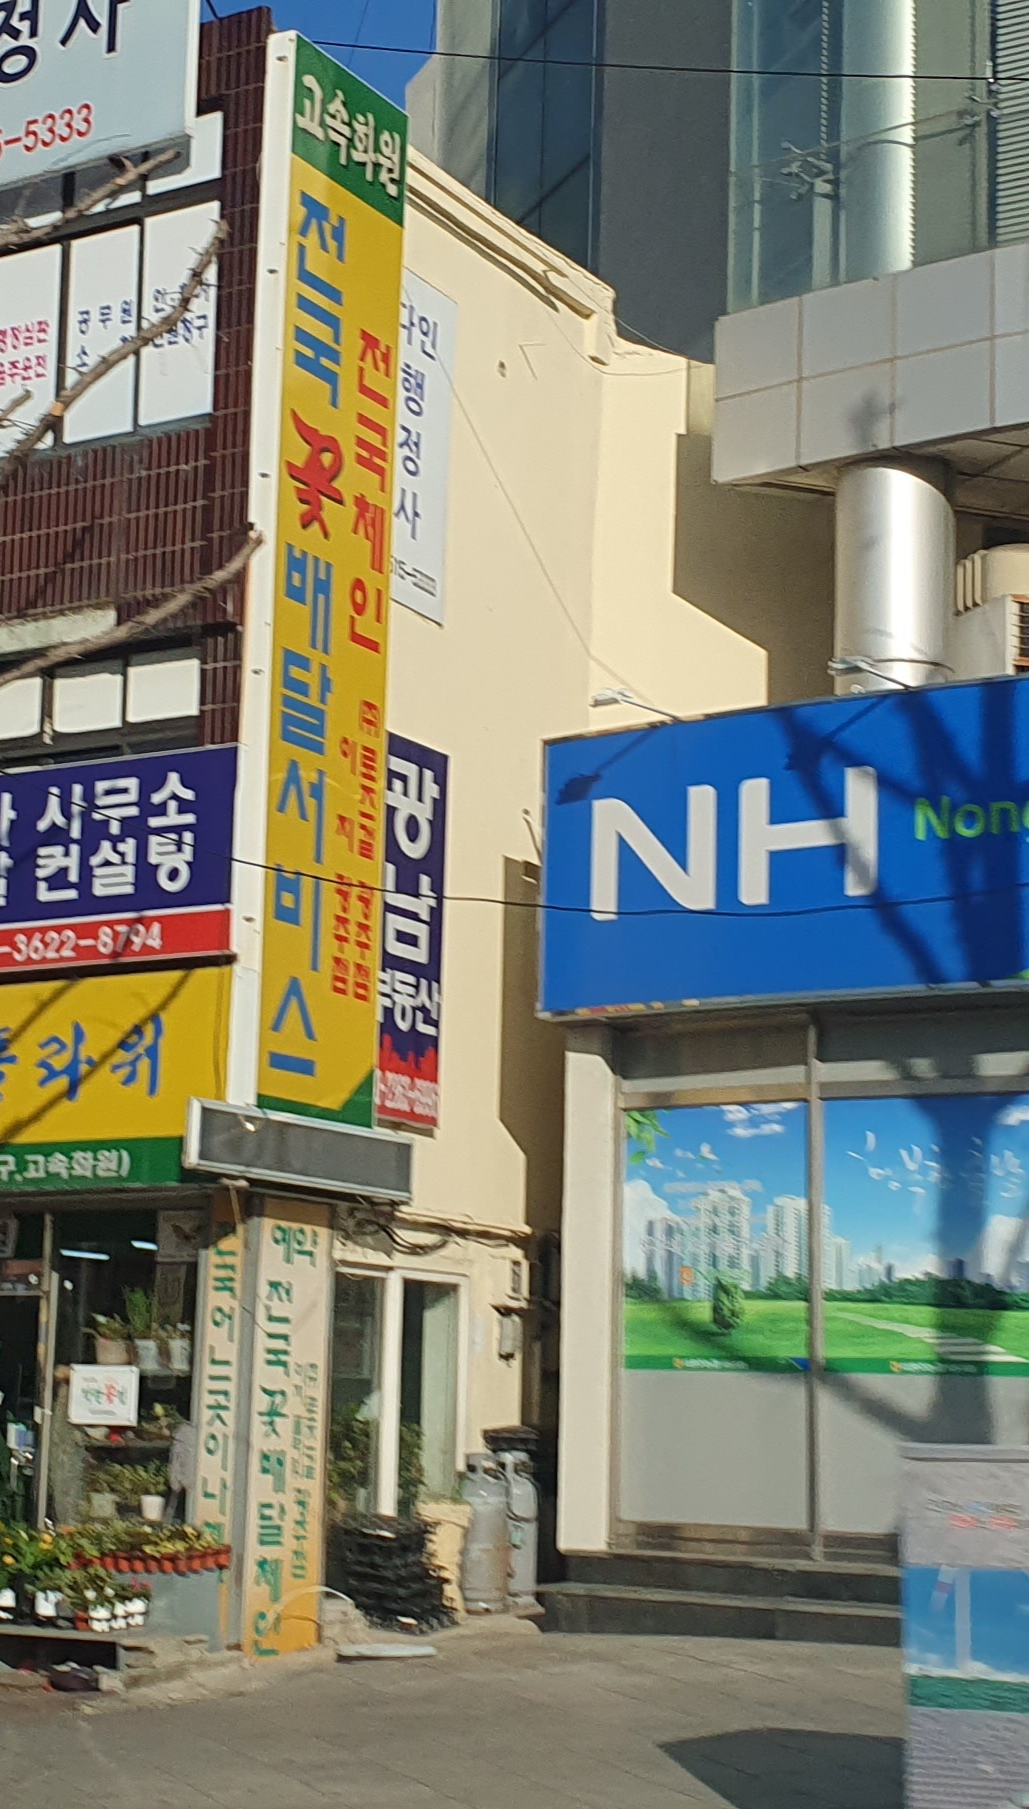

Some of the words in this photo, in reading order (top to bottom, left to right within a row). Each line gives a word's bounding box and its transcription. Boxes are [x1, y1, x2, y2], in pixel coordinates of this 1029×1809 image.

[294, 73, 402, 199] 고속화원
[35, 771, 197, 840] 사무소
[589, 766, 879, 921] NH
[913, 794, 1029, 842] Non
[34, 829, 196, 903] 컨설팅
[384, 754, 441, 965] 광남
